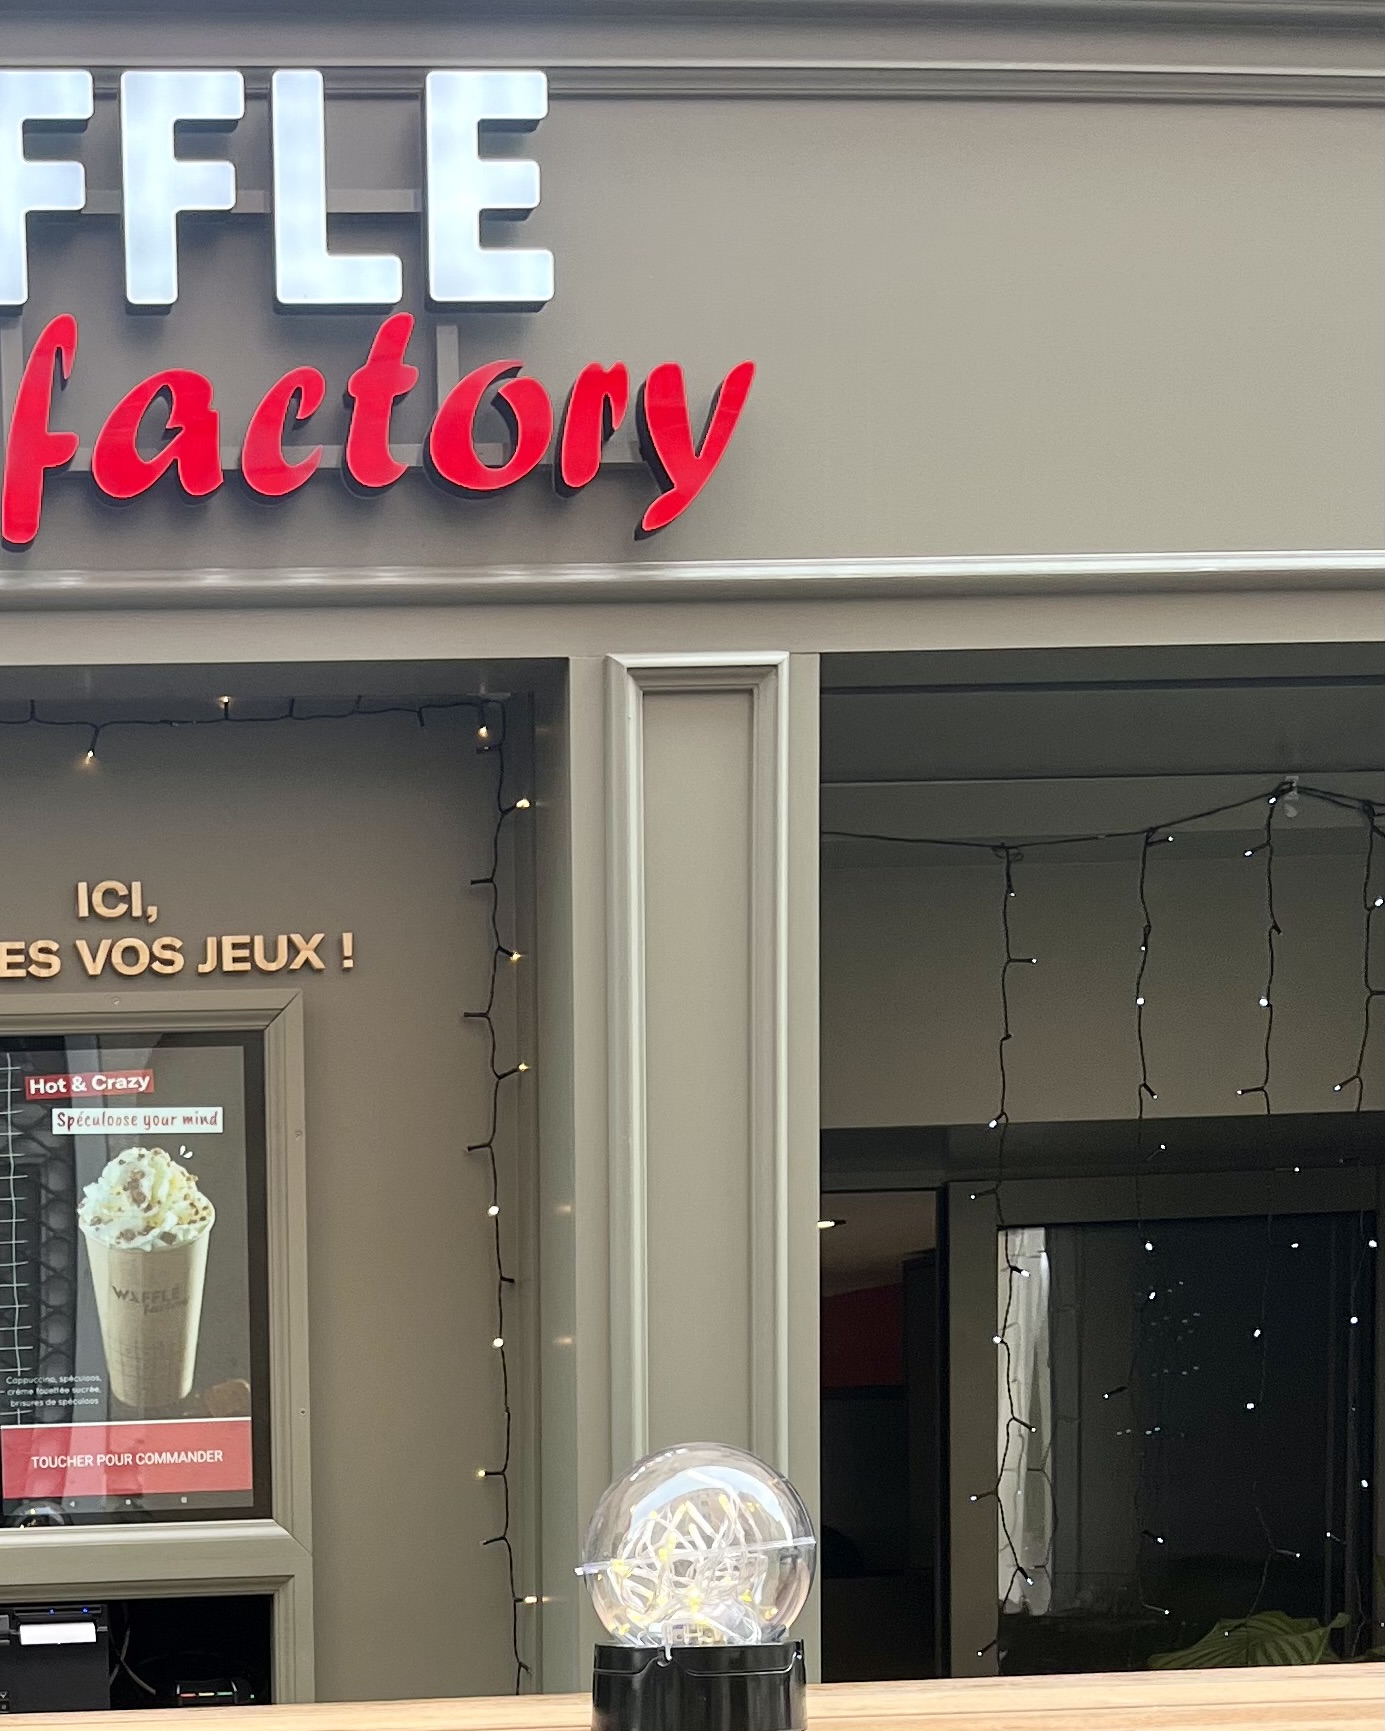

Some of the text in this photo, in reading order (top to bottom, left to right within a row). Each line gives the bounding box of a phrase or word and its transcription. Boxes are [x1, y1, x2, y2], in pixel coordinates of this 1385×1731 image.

[1, 313, 756, 545] factory
[76, 880, 159, 923] ICI,
[75, 936, 185, 976] VOS
[197, 932, 326, 974] JEUX
[29, 1074, 151, 1095] Hot & Crazy
[57, 1110, 218, 1131] Spéculoose your mind
[31, 1450, 223, 1469] TOUCHER POUR COMMANDER
